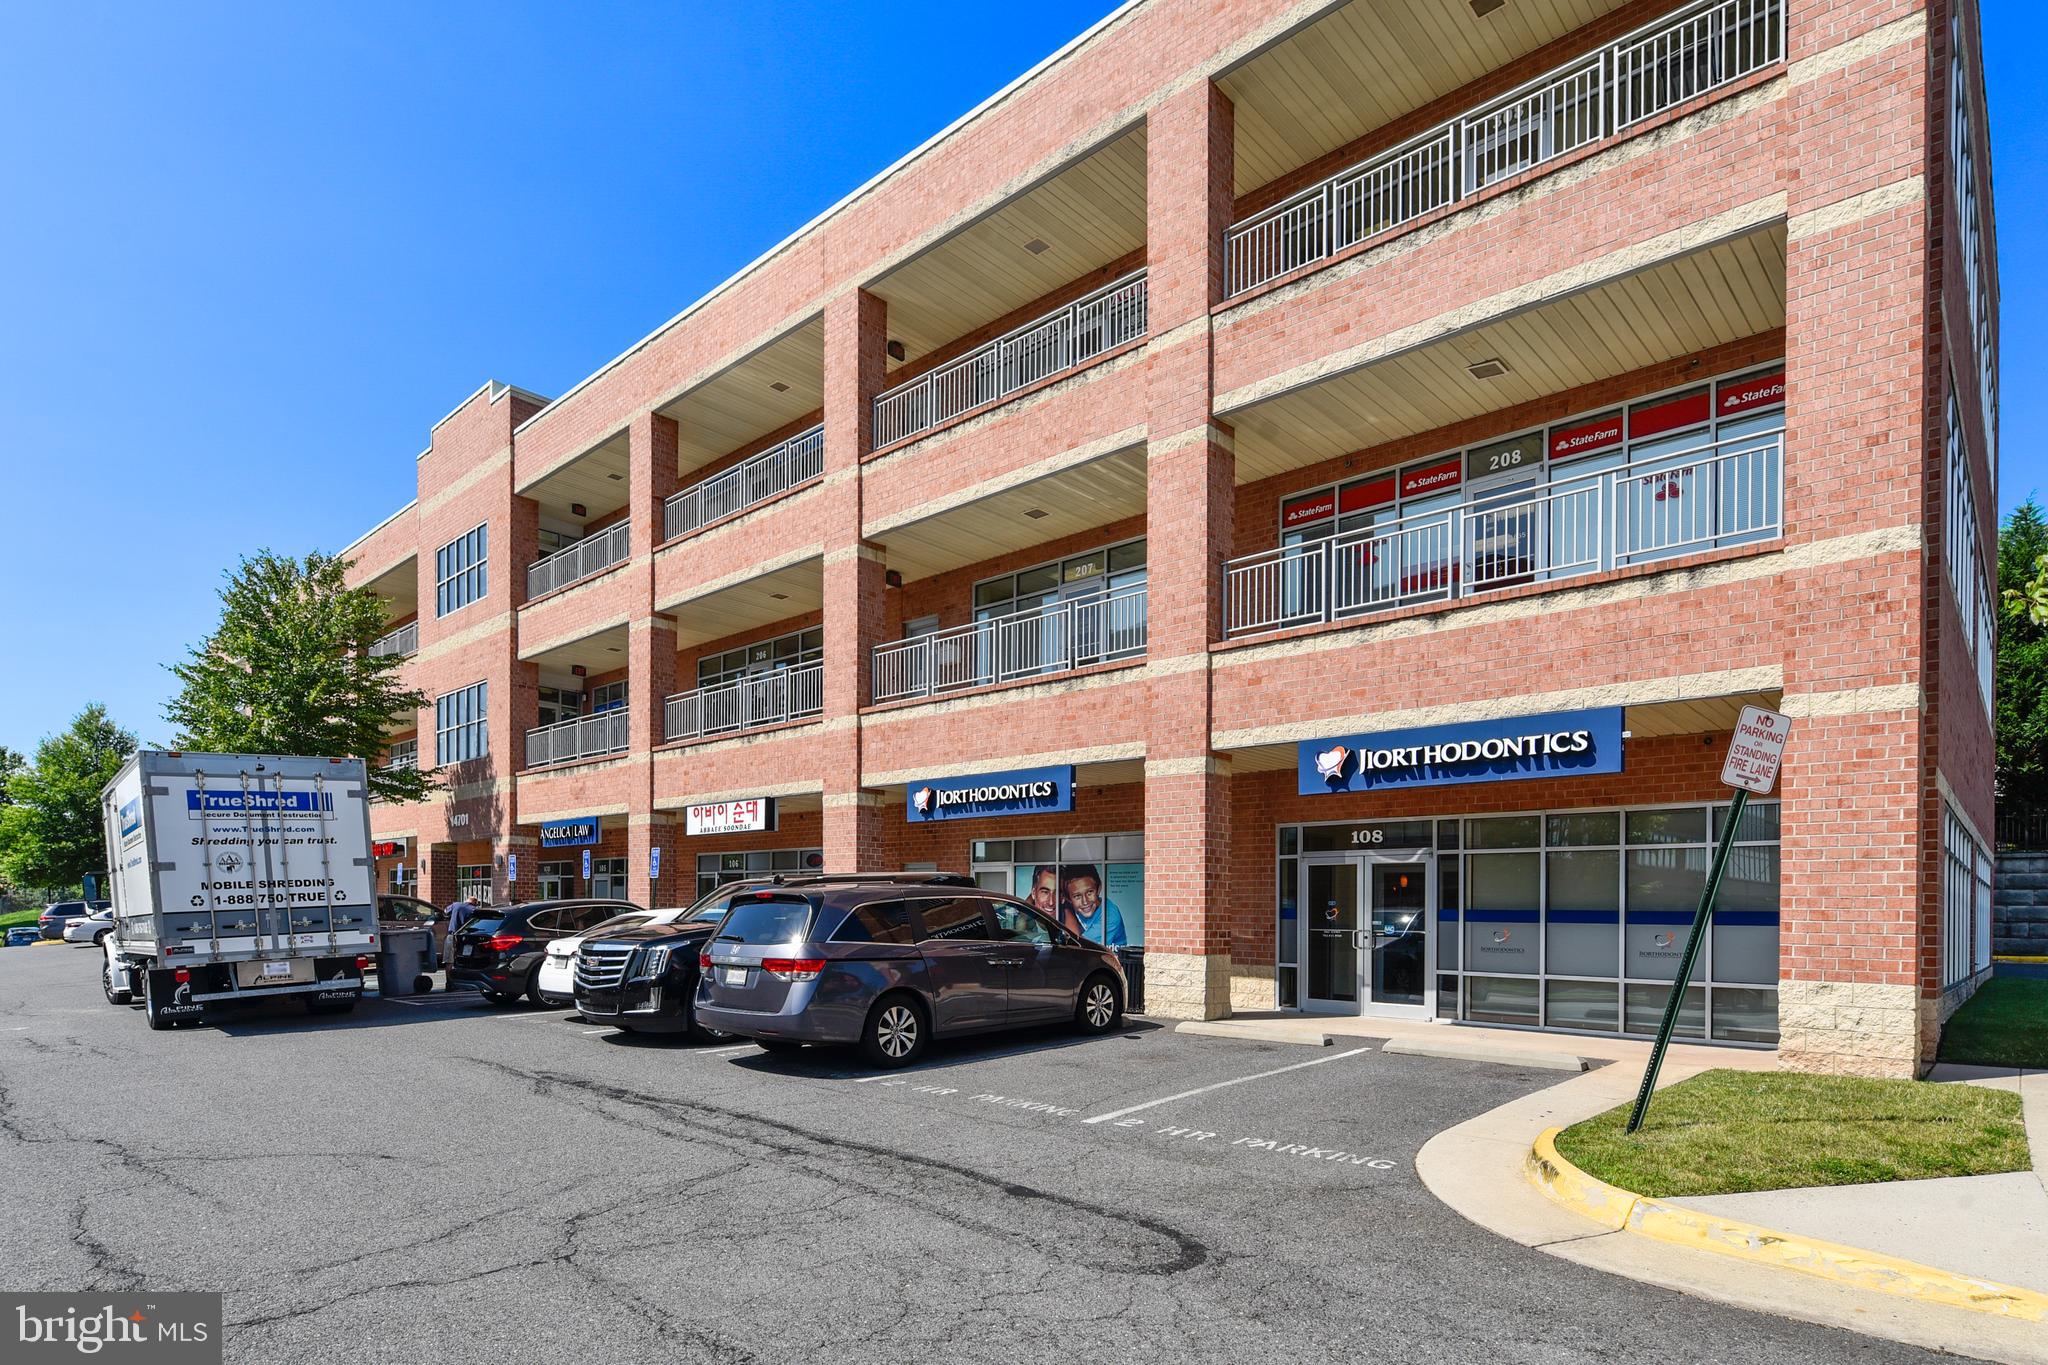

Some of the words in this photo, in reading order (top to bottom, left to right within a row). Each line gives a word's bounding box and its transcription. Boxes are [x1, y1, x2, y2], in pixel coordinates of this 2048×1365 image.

[1489, 450, 1521, 470] 208
[1075, 562, 1093, 577] 207
[1756, 715, 1774, 728] NO
[1739, 724, 1784, 744] PARKING
[1733, 744, 1777, 764] STANDING
[1728, 756, 1749, 772] FIRE
[1750, 762, 1774, 778] LANE
[196, 794, 298, 807] TrueShred
[693, 804, 728, 826] 아바이
[733, 800, 758, 823] 순대
[540, 826, 570, 839] ANGELICA
[574, 825, 589, 836] LAW
[1351, 830, 1384, 844] 108
[257, 838, 279, 847] you
[729, 860, 739, 868] 106
[201, 881, 254, 890] MOBILE
[258, 878, 335, 889] SHREDDING
[214, 892, 326, 905] 1-888-750-TRUE
[912, 1085, 958, 1095] HR
[968, 1094, 1080, 1117] PARKING
[1113, 1118, 1145, 1127] 2
[1156, 1126, 1216, 1141] HR
[1231, 1138, 1397, 1169] PARKING
